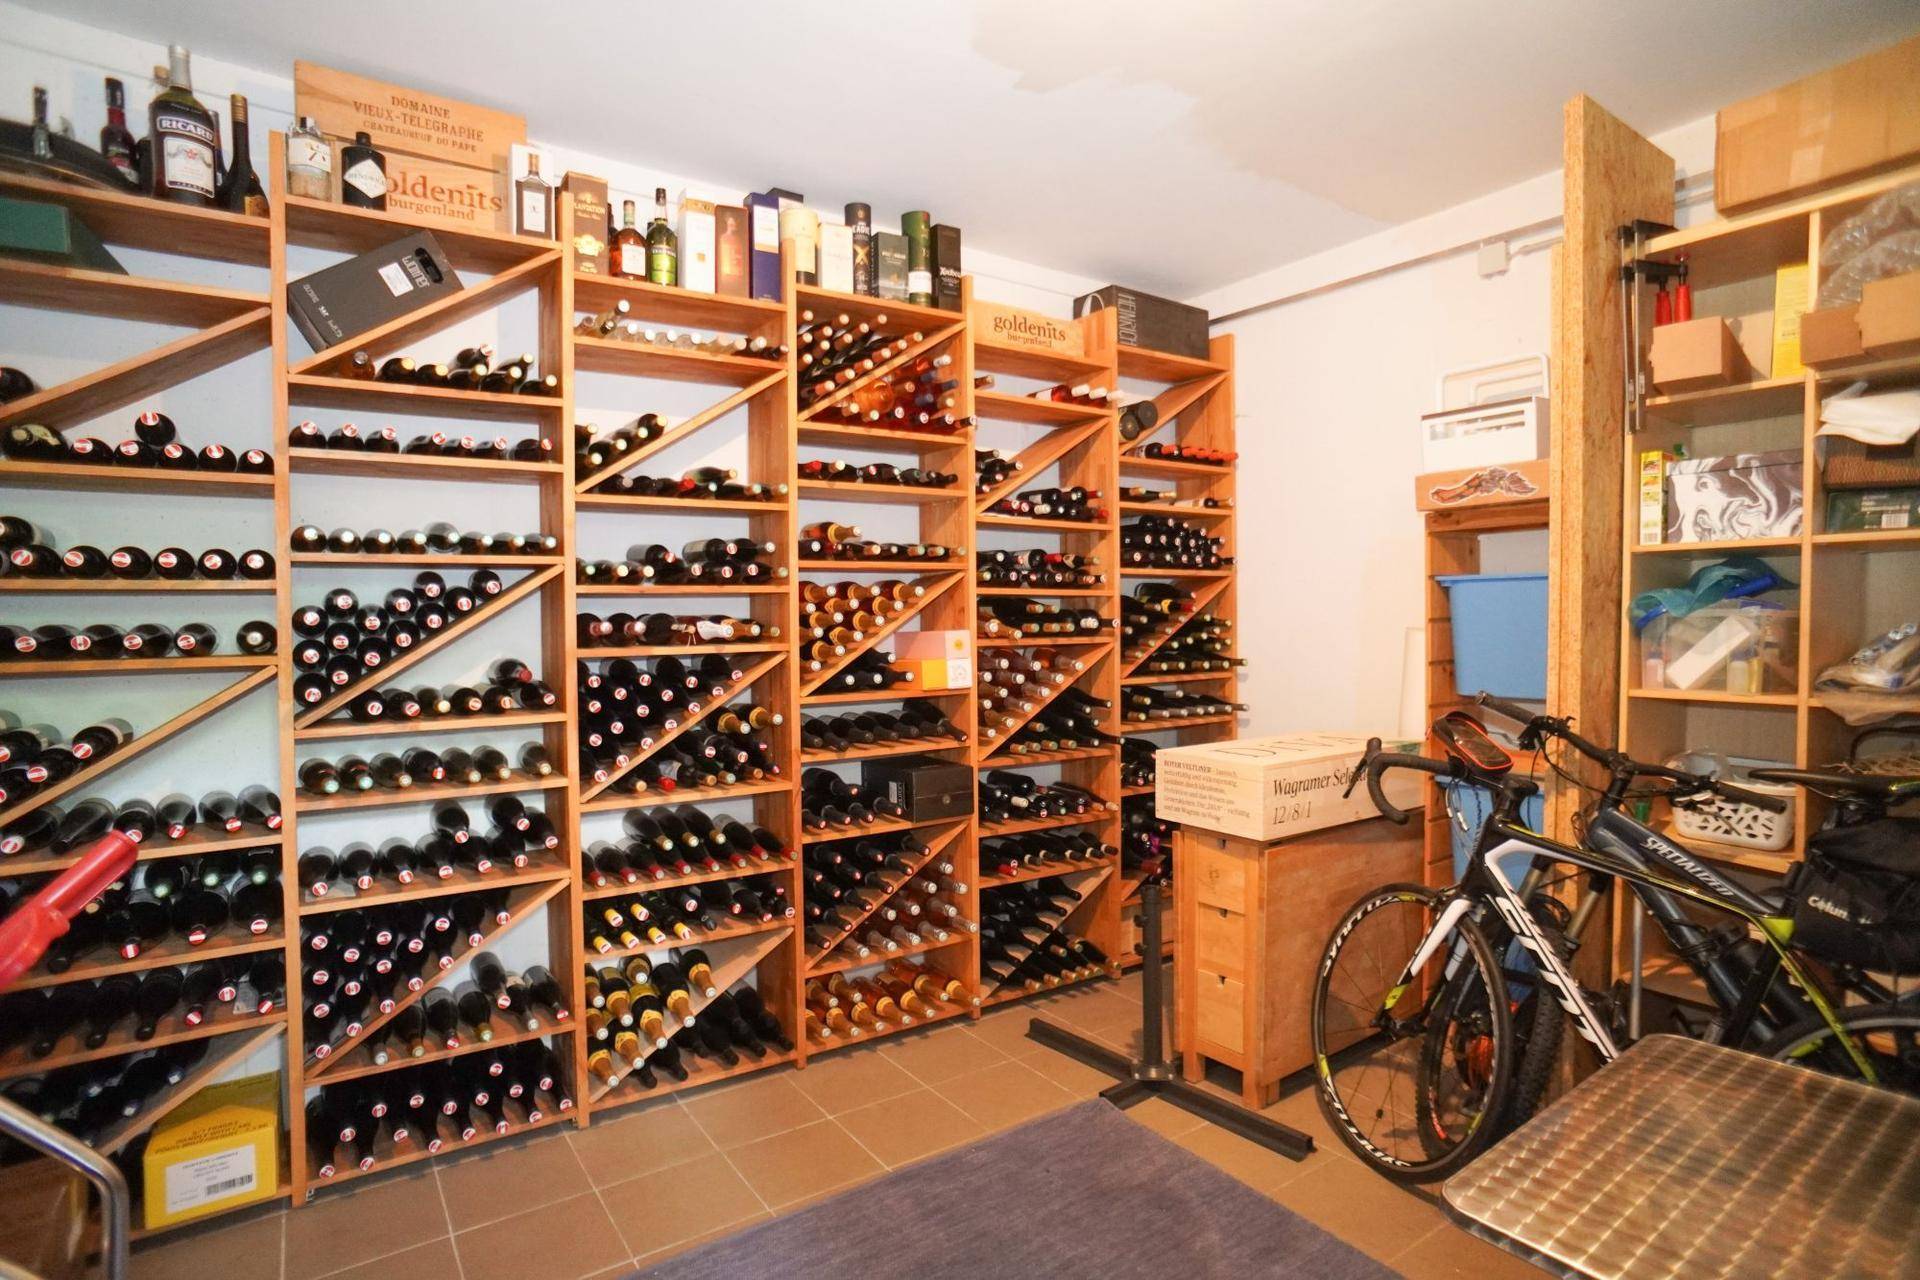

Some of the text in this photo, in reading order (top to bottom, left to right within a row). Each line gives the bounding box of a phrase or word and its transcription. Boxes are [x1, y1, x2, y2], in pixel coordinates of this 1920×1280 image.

[353, 101, 484, 142] VIEUX-TELEGRAPHE
[391, 96, 450, 119] DOMAINE
[161, 119, 213, 141] RICARD
[363, 120, 477, 152] CHATEAUNEUF DU PAPE
[385, 171, 503, 212] oldenits
[388, 194, 475, 221] burgenland
[1118, 292, 1138, 347] HEINRICH
[1273, 777, 1331, 798] Wagramer
[1640, 837, 1734, 896] SPECIALIZED
